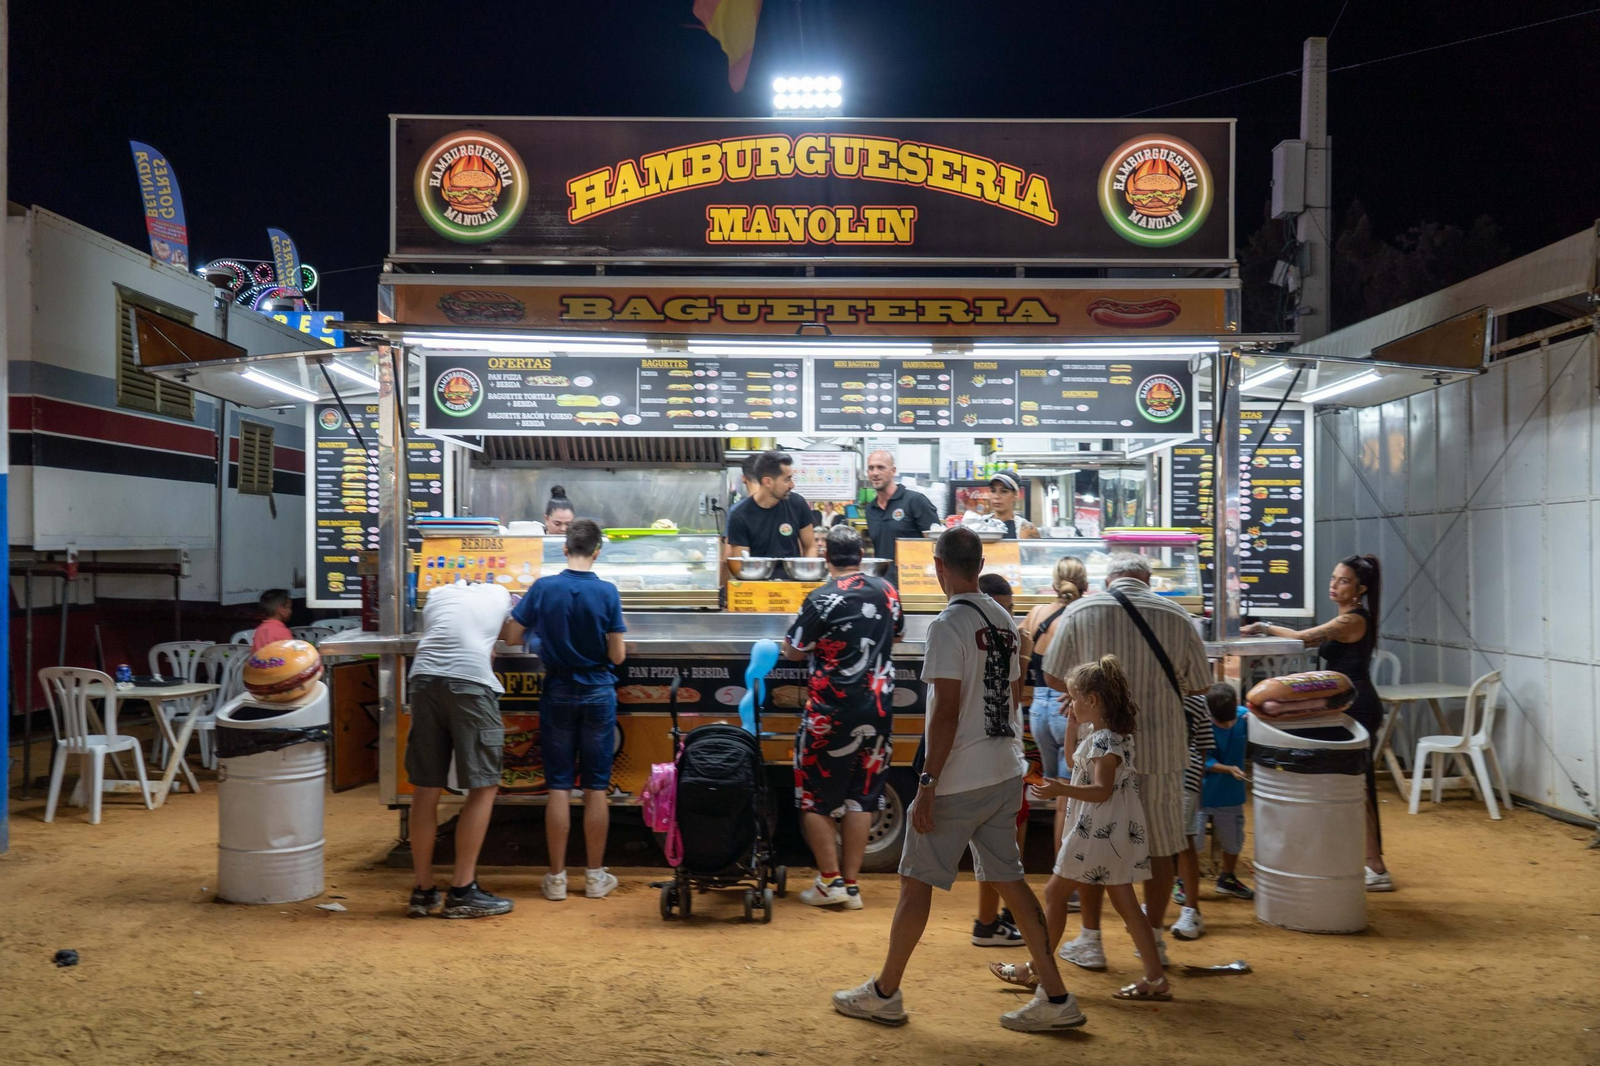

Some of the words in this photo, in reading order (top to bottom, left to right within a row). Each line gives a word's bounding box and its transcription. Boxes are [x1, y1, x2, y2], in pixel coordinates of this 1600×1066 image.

[429, 144, 513, 188] HAMBURGUESERIA
[1113, 147, 1199, 191] HAMBURGUESERIA
[567, 135, 1057, 225] HAMBURGUESERIA
[443, 206, 499, 226] MANOLIN
[708, 206, 916, 243] MANOLIN
[1127, 209, 1183, 230] MANOLIN
[560, 296, 1058, 324] BAGUETERIA
[488, 358, 552, 370] OFERTAS
[641, 359, 688, 368] BAGUETTES
[461, 538, 504, 550] BEBIDAS
[628, 667, 649, 678] PAN
[651, 667, 680, 678] PIZZA
[682, 669, 689, 677] +
[692, 667, 730, 679] BEBIDA
[723, 688, 734, 703] 5
